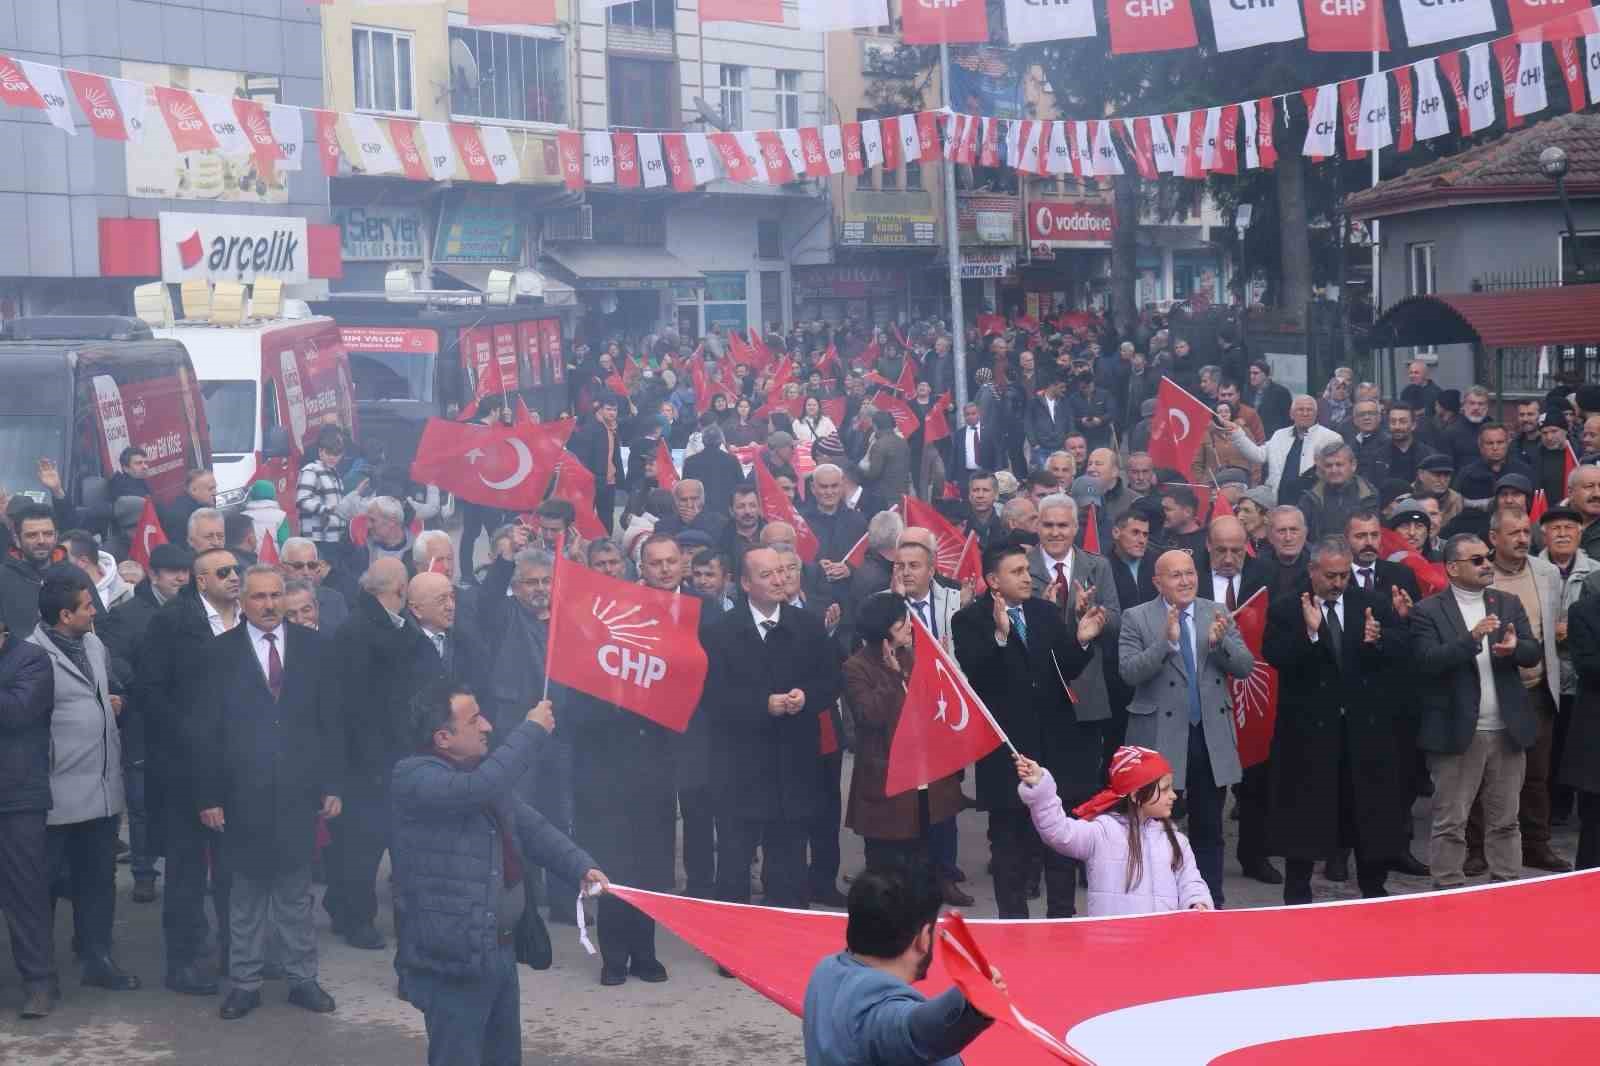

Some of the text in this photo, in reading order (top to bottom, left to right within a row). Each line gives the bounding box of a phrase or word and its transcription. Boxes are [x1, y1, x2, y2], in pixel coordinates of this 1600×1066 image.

[1125, 1, 1174, 17] CHP
[1320, 0, 1366, 16] CHP
[177, 119, 203, 131] CHP
[212, 123, 236, 135] CHP
[1056, 212, 1112, 231] vodafone
[207, 230, 298, 281] arçelik
[598, 644, 668, 689] CHP
[1233, 679, 1244, 728] CHP
